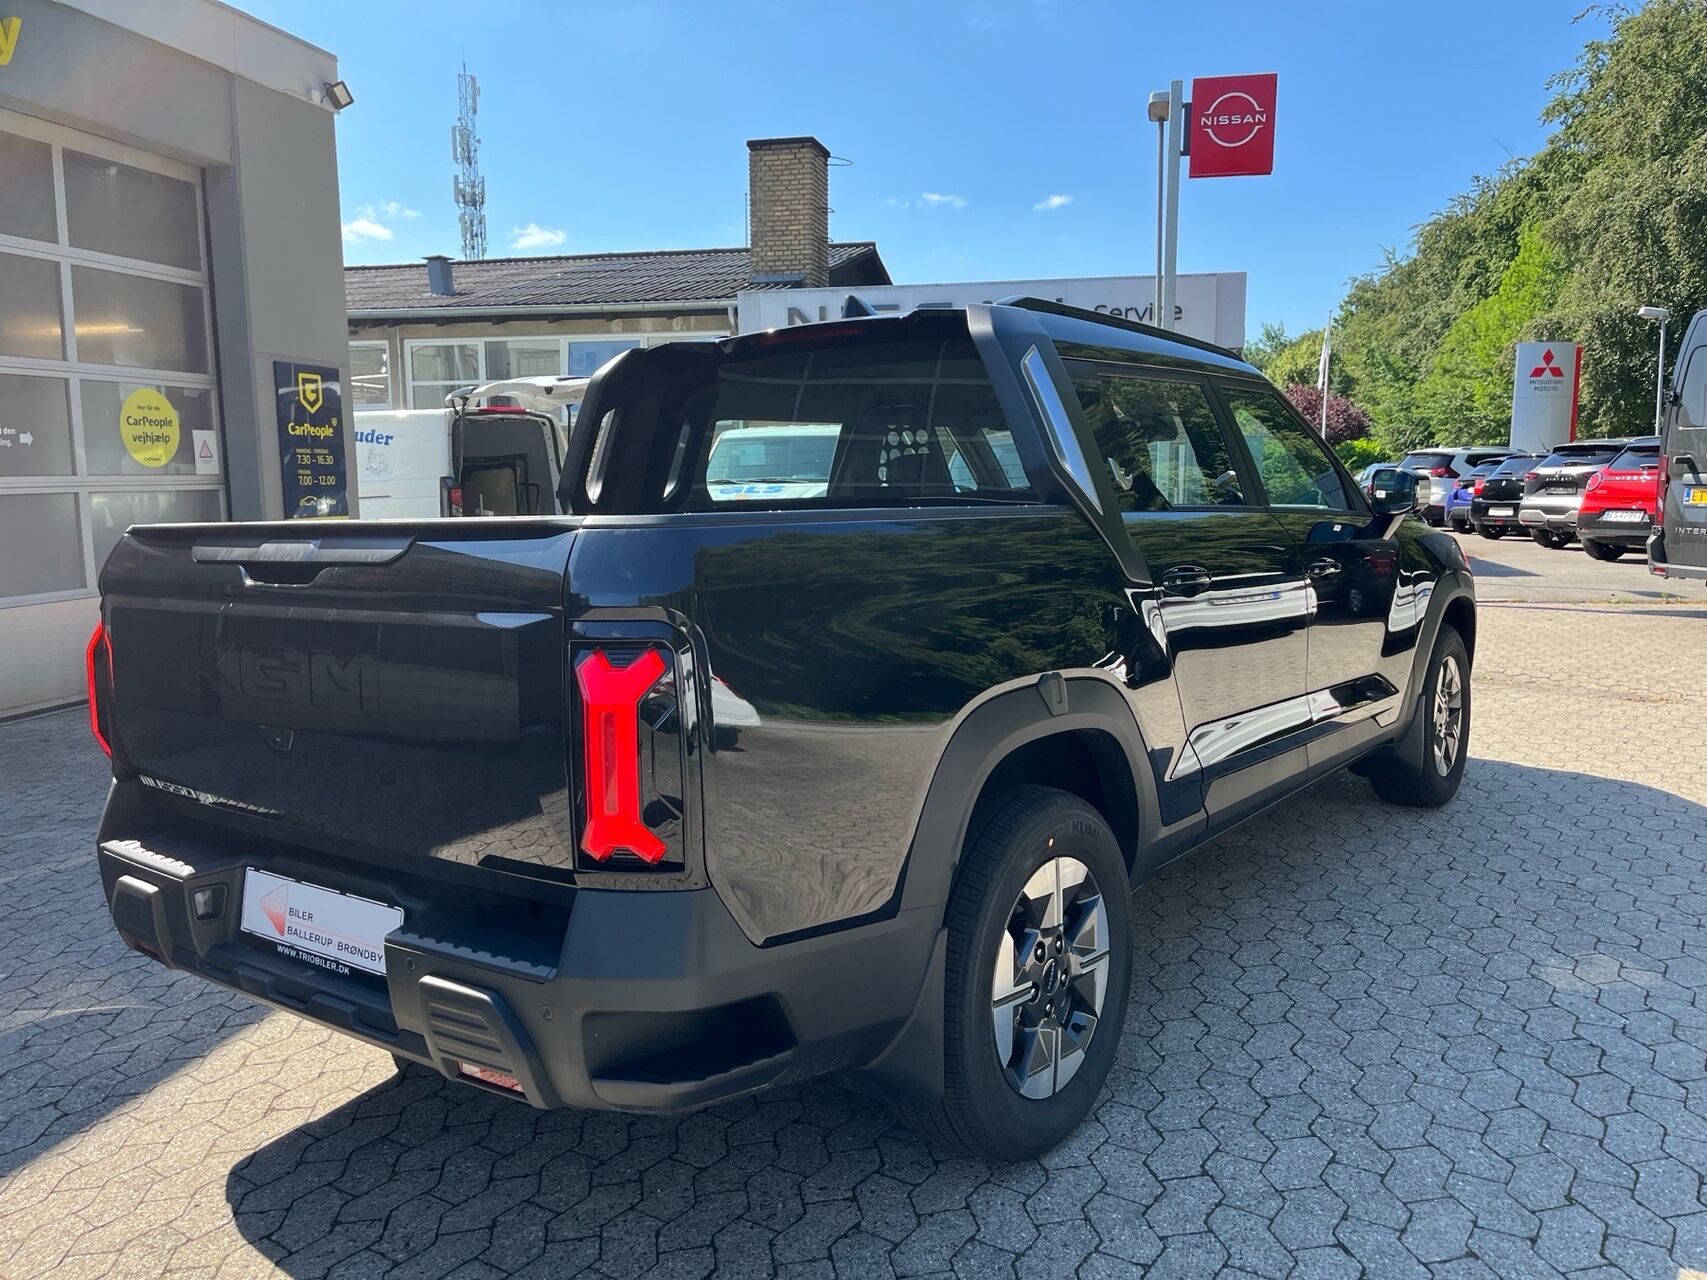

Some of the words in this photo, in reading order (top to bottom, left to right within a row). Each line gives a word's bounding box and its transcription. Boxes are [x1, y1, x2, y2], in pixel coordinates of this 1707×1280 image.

[1201, 113, 1266, 126] NISSAN
[1094, 302, 1183, 322] ervie
[126, 416, 173, 429] CarPeople
[288, 422, 334, 440] CarPeople
[132, 432, 171, 445] vejhjælp
[1675, 526, 1707, 535] INTER
[183, 637, 381, 713] KGM
[139, 774, 197, 799] MUSSO
[288, 907, 314, 922] BILER
[287, 926, 333, 947] BALLERUP
[337, 941, 384, 963] BRØNDBY
[277, 944, 350, 975] WWW.TRIOBILER.DK
